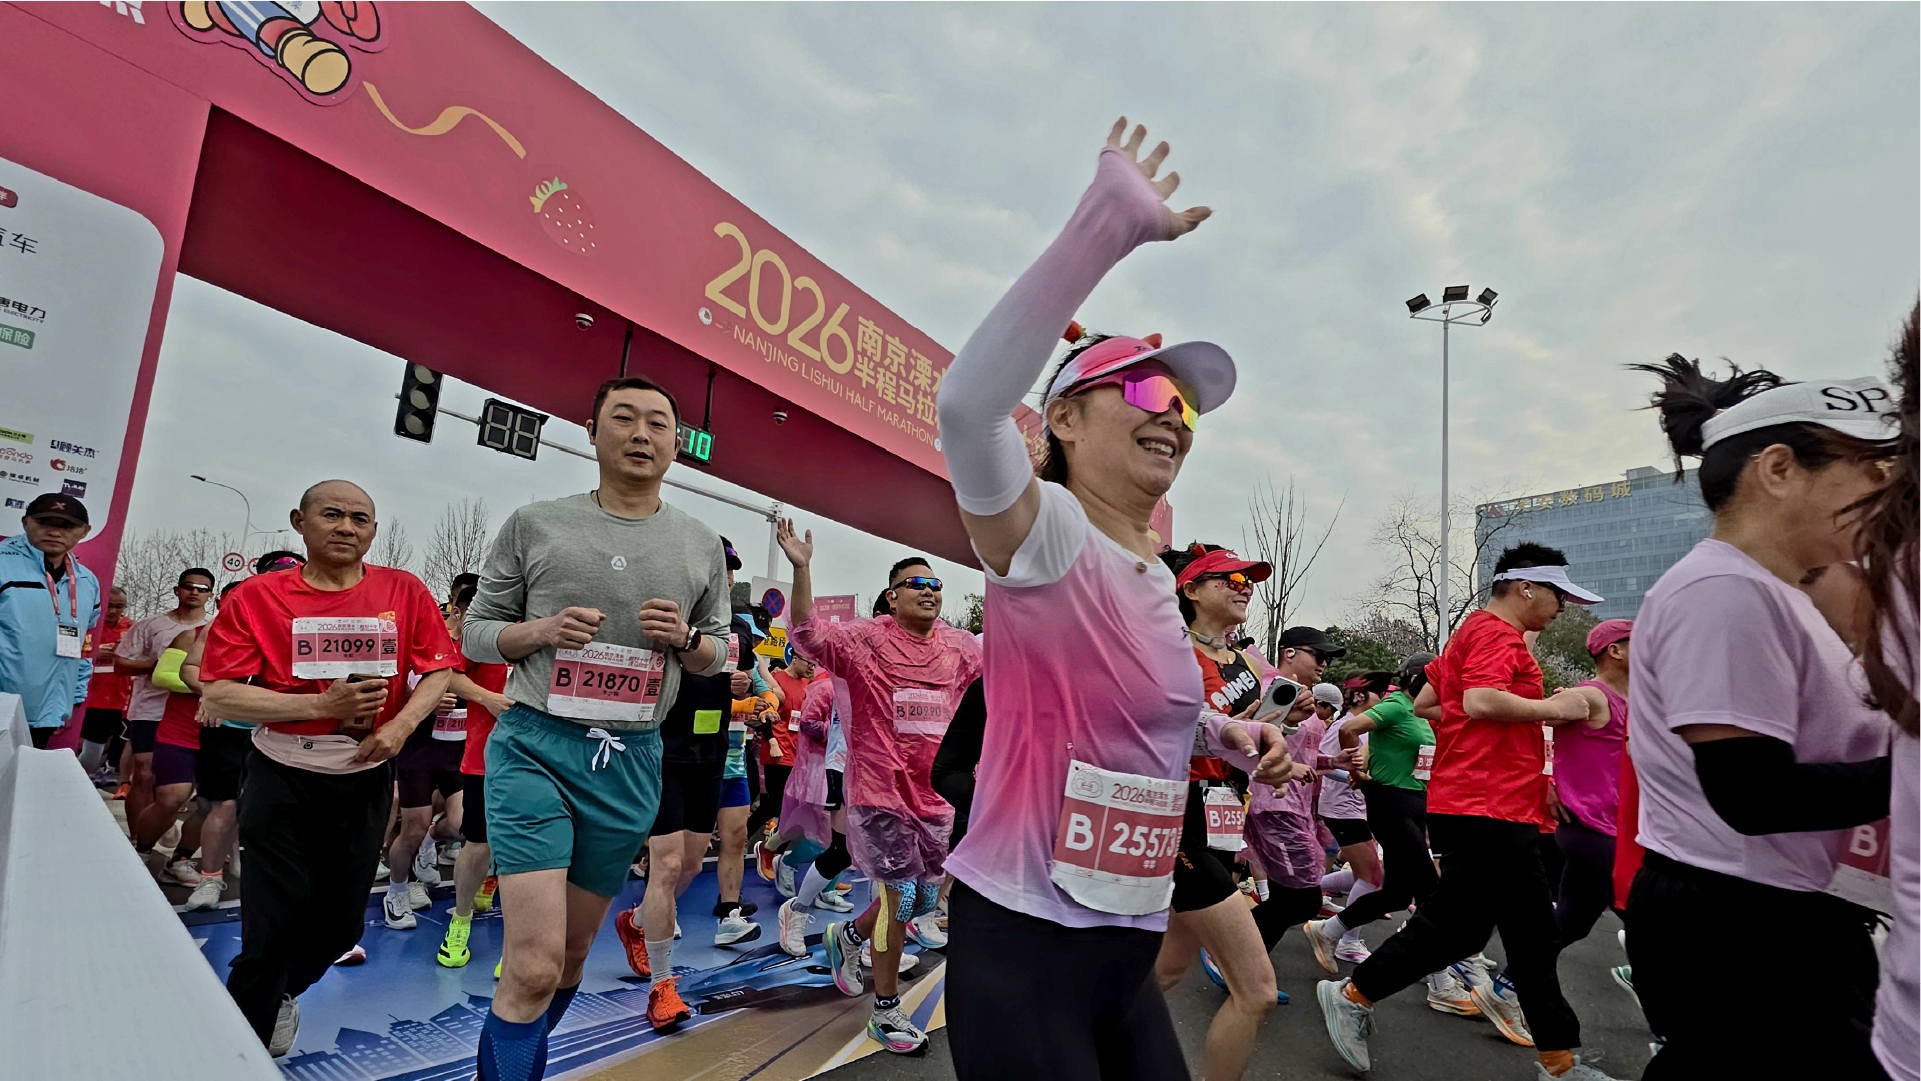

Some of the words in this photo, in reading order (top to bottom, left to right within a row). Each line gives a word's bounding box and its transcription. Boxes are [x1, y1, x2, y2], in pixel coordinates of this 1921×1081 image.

[0, 227, 38, 254] 车
[705, 222, 854, 374] 2026
[733, 325, 798, 373] NANJING
[802, 363, 843, 398] LISHUI
[846, 387, 876, 413] HALF
[877, 405, 934, 446] MARATHON
[854, 354, 942, 431] 半程马拉
[226, 557, 242, 568] 40
[297, 639, 313, 656] B
[322, 638, 376, 653] 21099
[381, 637, 397, 655] 壹
[582, 648, 605, 660] 2026
[555, 667, 572, 687] B
[582, 670, 641, 693] 21870
[645, 677, 662, 697] 壹
[896, 705, 906, 718] B
[909, 705, 942, 717] 20990
[436, 719, 445, 728] B
[1417, 757, 1424, 767] B
[1111, 782, 1146, 804] 2026
[1208, 810, 1221, 828] B
[1064, 812, 1095, 851] B
[1848, 823, 1879, 858] B
